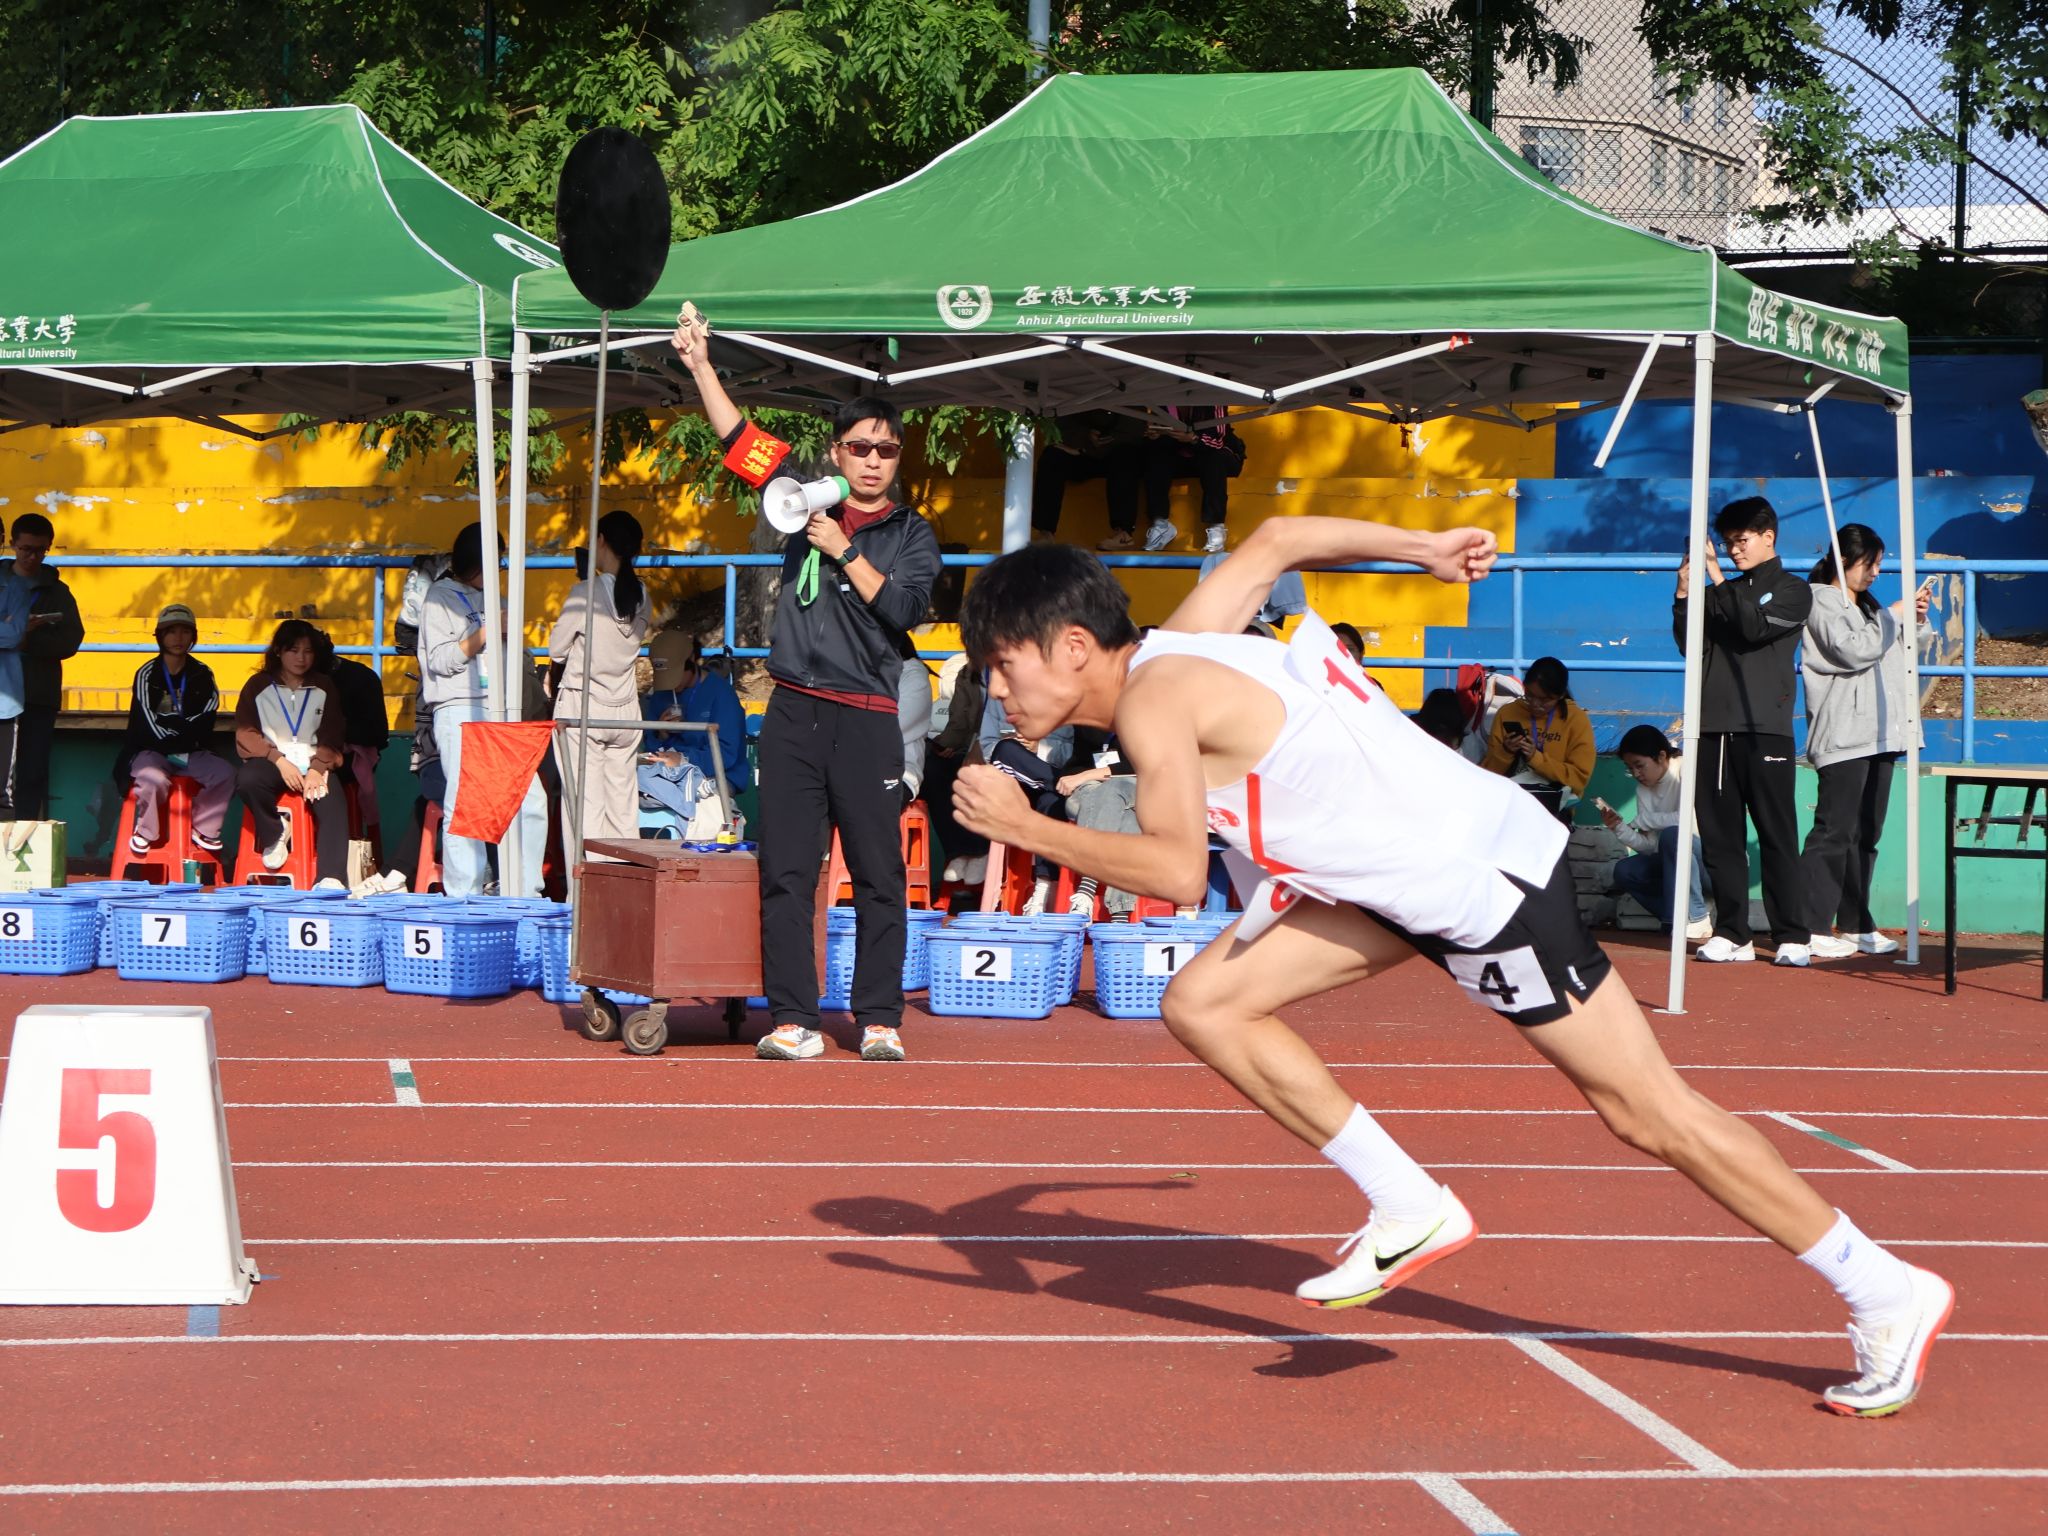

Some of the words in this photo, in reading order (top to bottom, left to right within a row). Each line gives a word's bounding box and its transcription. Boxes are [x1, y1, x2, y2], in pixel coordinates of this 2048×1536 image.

[1016, 314, 1053, 326] Anhui
[1055, 313, 1128, 327] Agricultural
[1132, 312, 1194, 326] University
[28, 347, 78, 360] University
[2, 911, 21, 937] 8
[154, 916, 173, 943] 7
[300, 921, 319, 947] 6
[414, 929, 431, 955] 5
[974, 949, 997, 977] 2
[1160, 945, 1176, 972] 1
[1479, 960, 1520, 1006] 4
[56, 1067, 157, 1233] 5
